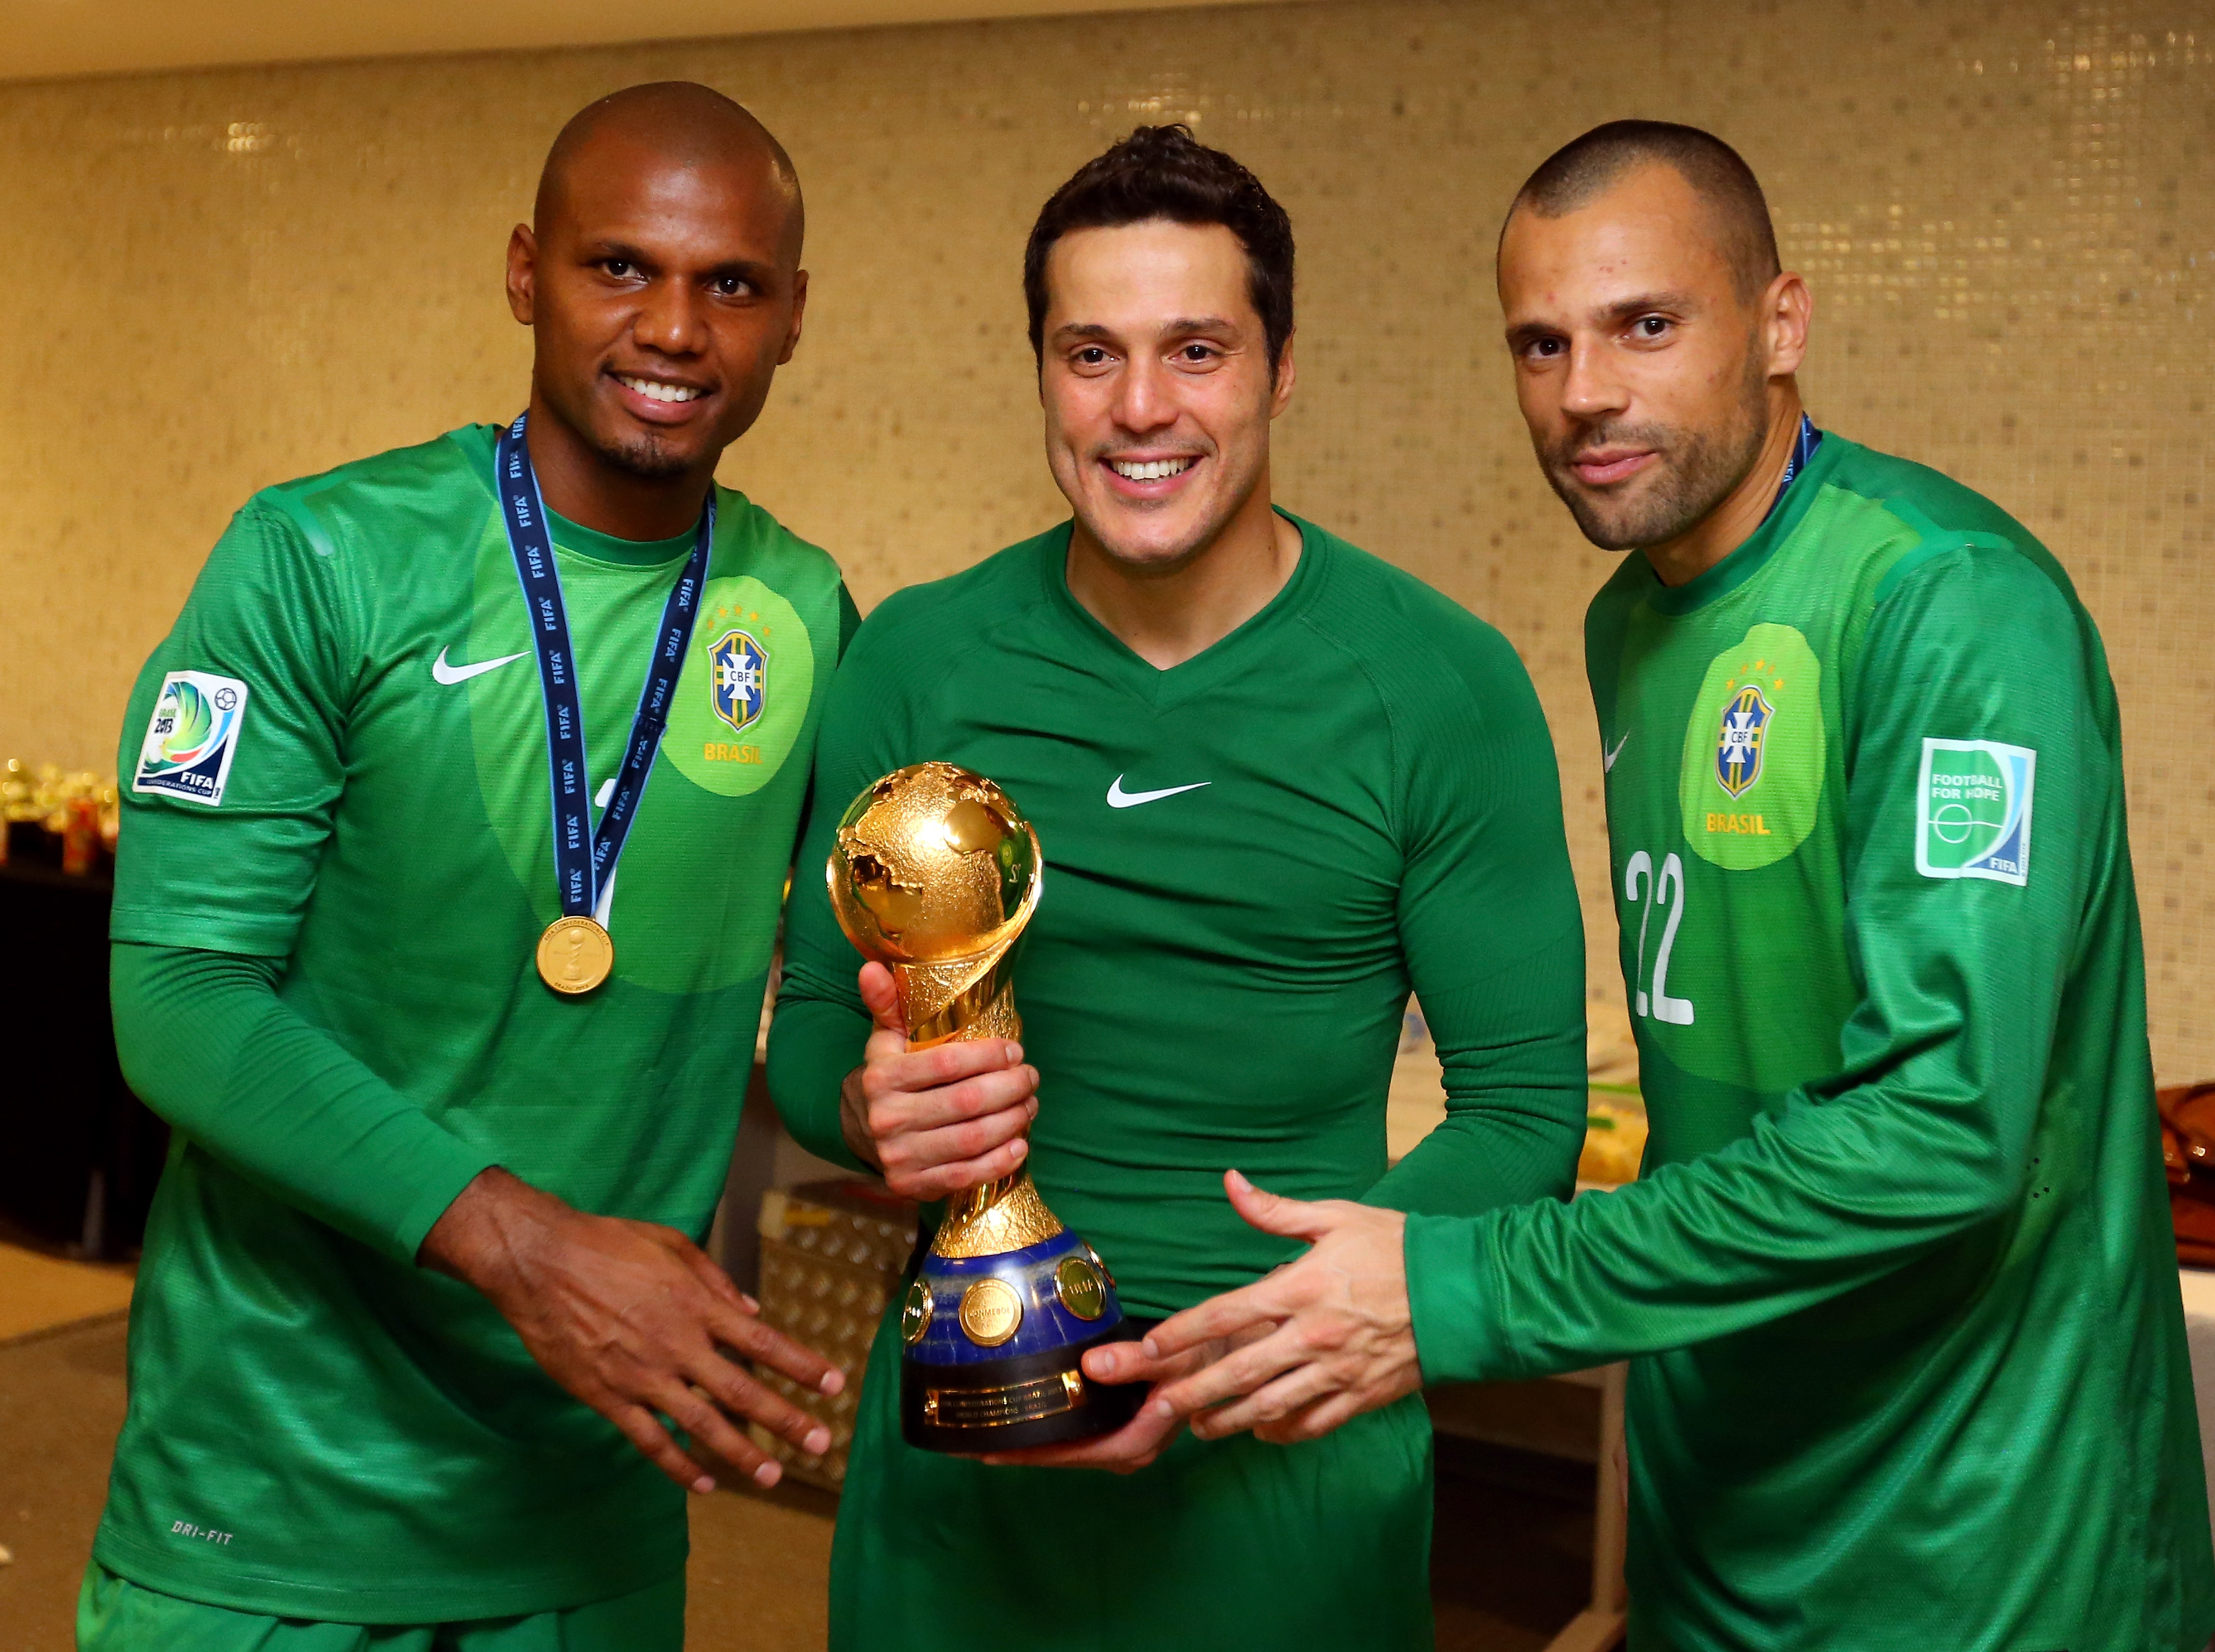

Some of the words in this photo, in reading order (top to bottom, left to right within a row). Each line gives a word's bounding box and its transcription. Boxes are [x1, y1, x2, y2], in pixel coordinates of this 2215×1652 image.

[515, 496, 532, 528] FIFA
[529, 546, 546, 579] FIFA
[679, 578, 694, 607] FIFA
[542, 598, 557, 631] FIFA
[665, 628, 682, 657] FIFA
[551, 651, 565, 685] FIFA
[730, 671, 751, 683] CBF
[650, 678, 668, 708] FIFA
[559, 706, 571, 740] FIFA
[1731, 731, 1748, 743] CBF
[703, 742, 763, 764] BRASIL
[180, 771, 214, 789] FIFA
[563, 760, 576, 794] FIFA
[1932, 774, 2002, 789] FOOTBALL
[197, 788, 212, 796] CUP
[612, 790, 630, 821] FIFA
[1931, 788, 1961, 800] FOR
[1966, 788, 2000, 801] HOPE
[567, 816, 579, 850] FIFA
[1706, 813, 1771, 834] BRASIL
[1989, 856, 2019, 874] FIFA
[570, 870, 583, 904] FIFA
[1625, 850, 1695, 1026] 22
[171, 1520, 234, 1545] DRI-FIT
